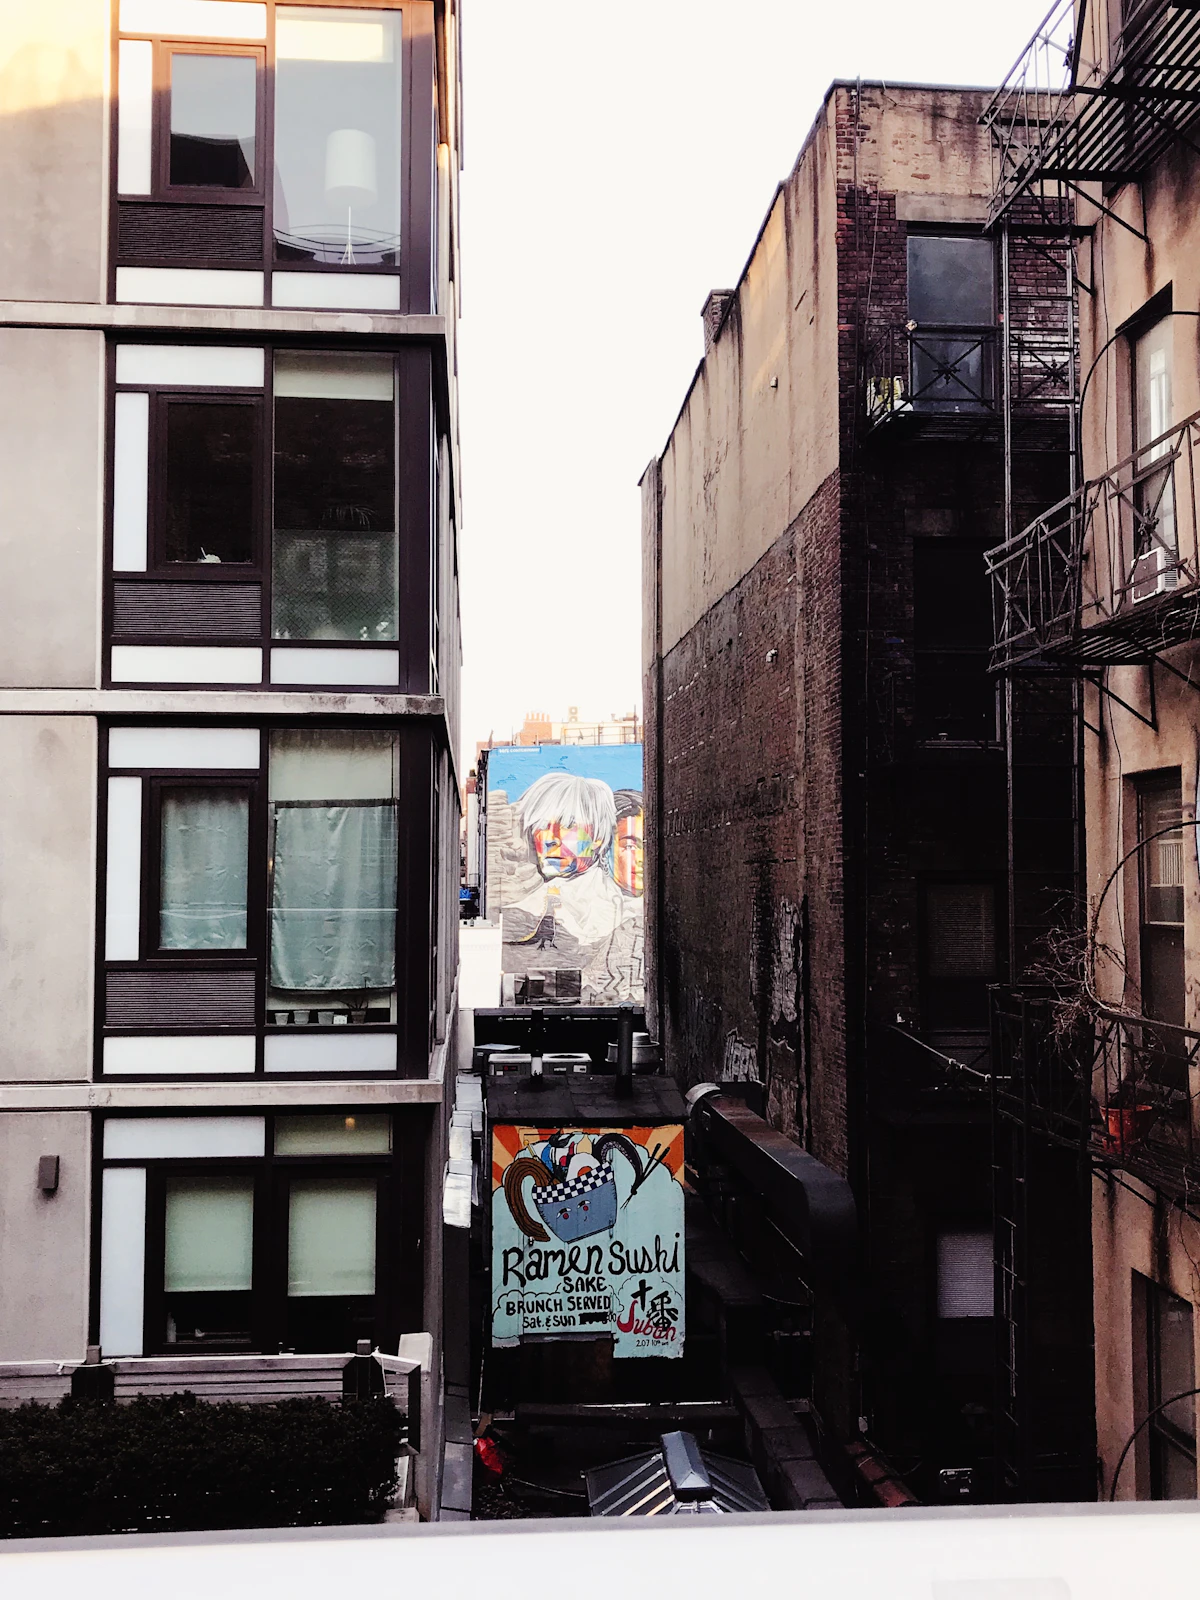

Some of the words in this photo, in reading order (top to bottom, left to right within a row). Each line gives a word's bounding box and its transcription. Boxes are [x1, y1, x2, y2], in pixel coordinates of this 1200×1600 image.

[502, 1245, 604, 1287] Ramen
[608, 1232, 680, 1276] Sushi
[562, 1276, 608, 1293] SAKE
[505, 1298, 563, 1316] BRUNCH
[567, 1295, 611, 1311] SERVED
